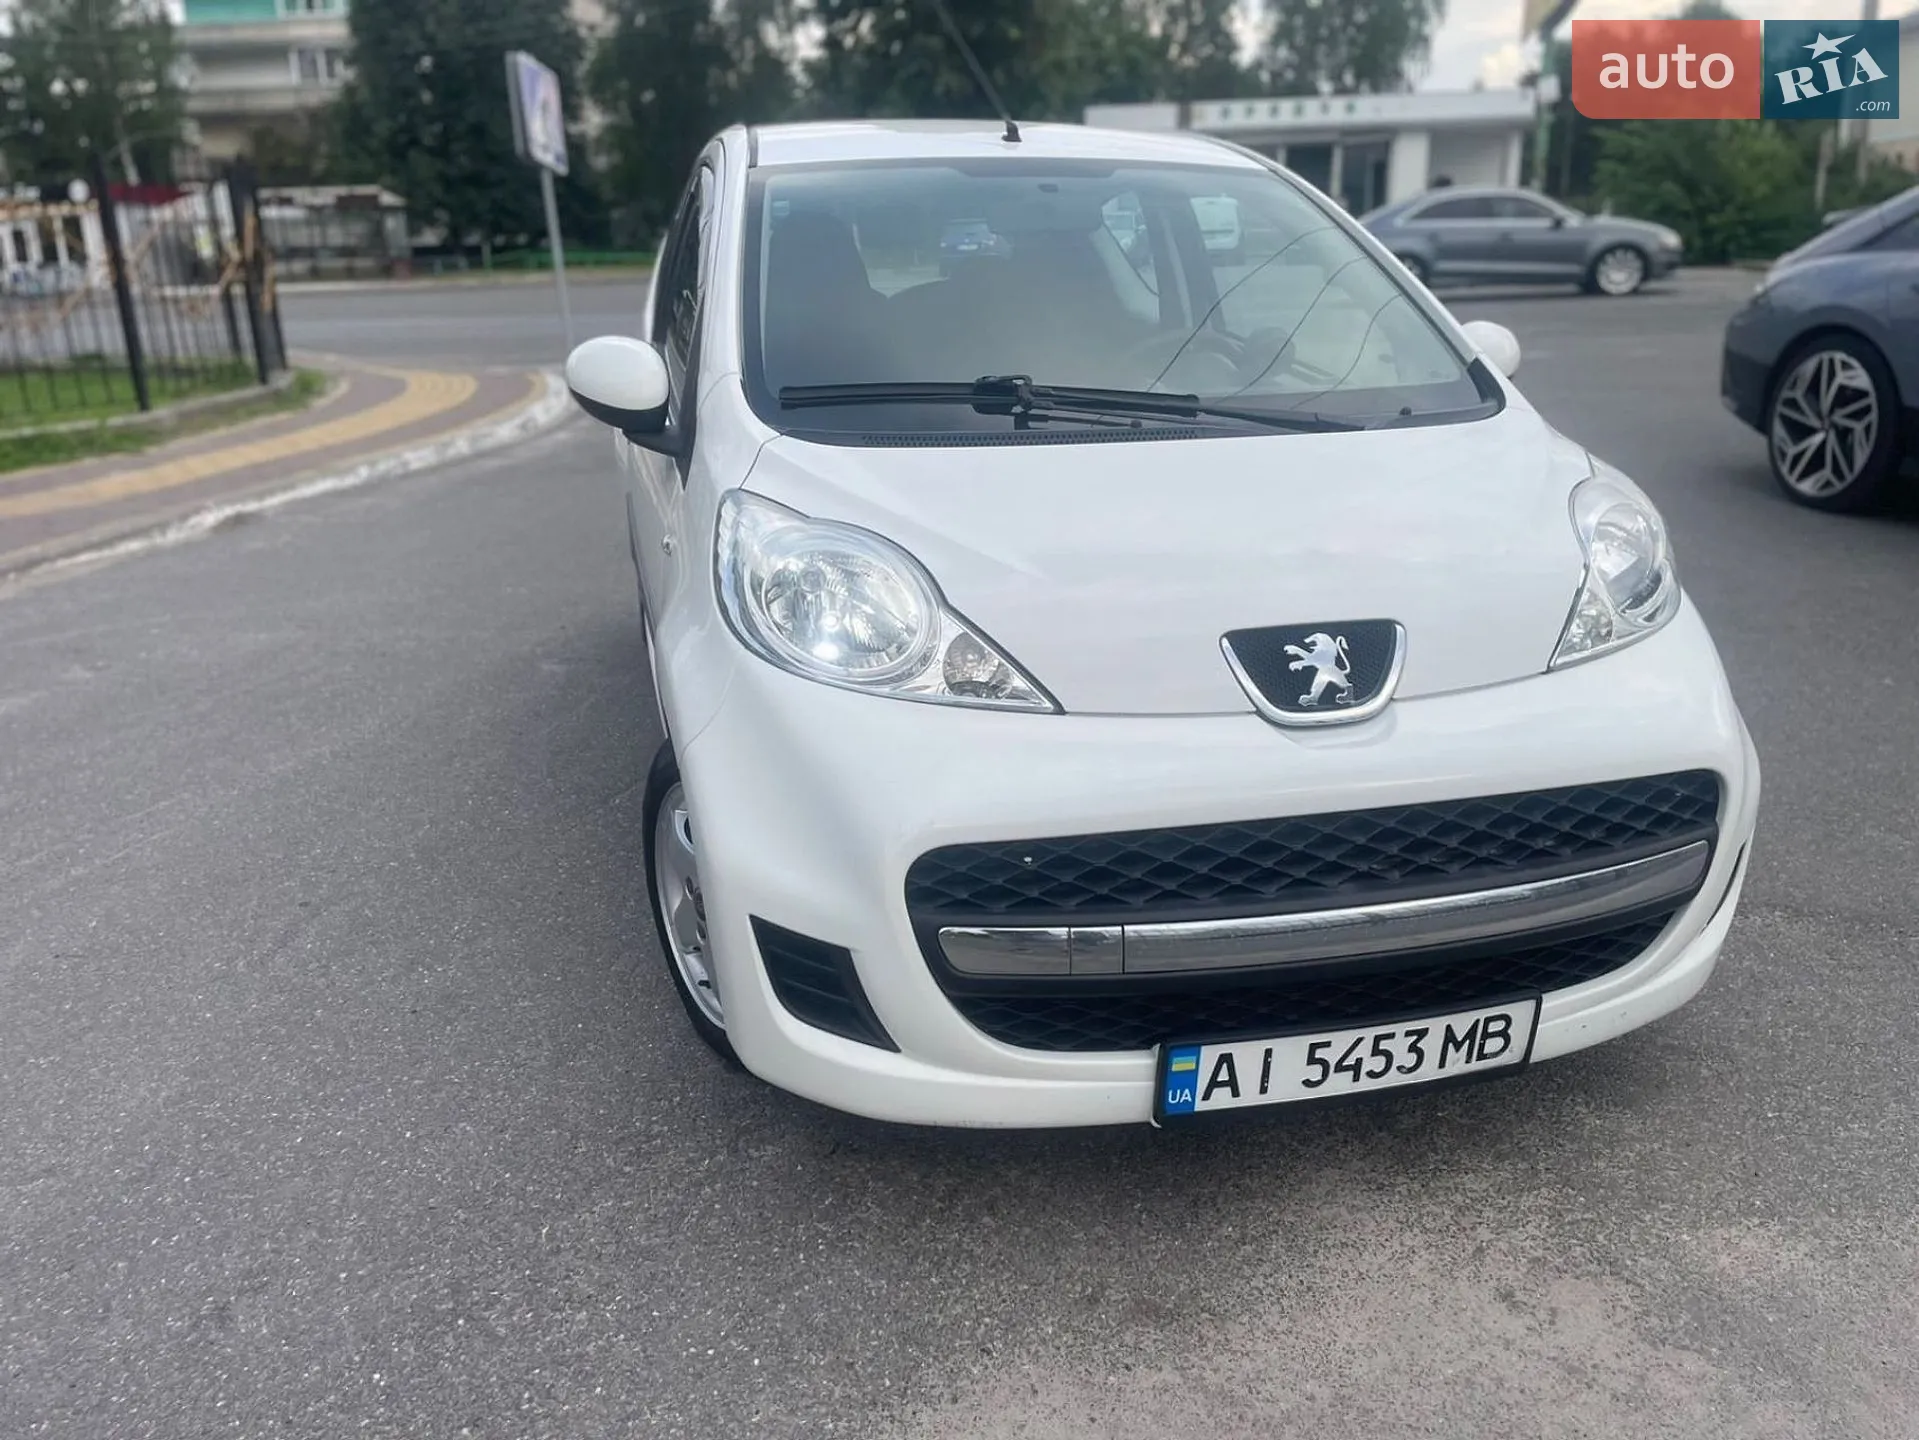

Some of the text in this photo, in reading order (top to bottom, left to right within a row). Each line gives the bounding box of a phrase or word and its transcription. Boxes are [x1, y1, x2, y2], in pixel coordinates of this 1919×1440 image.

[1201, 1013, 1512, 1101] AI 5453 MB
[1168, 1091, 1192, 1104] UA
